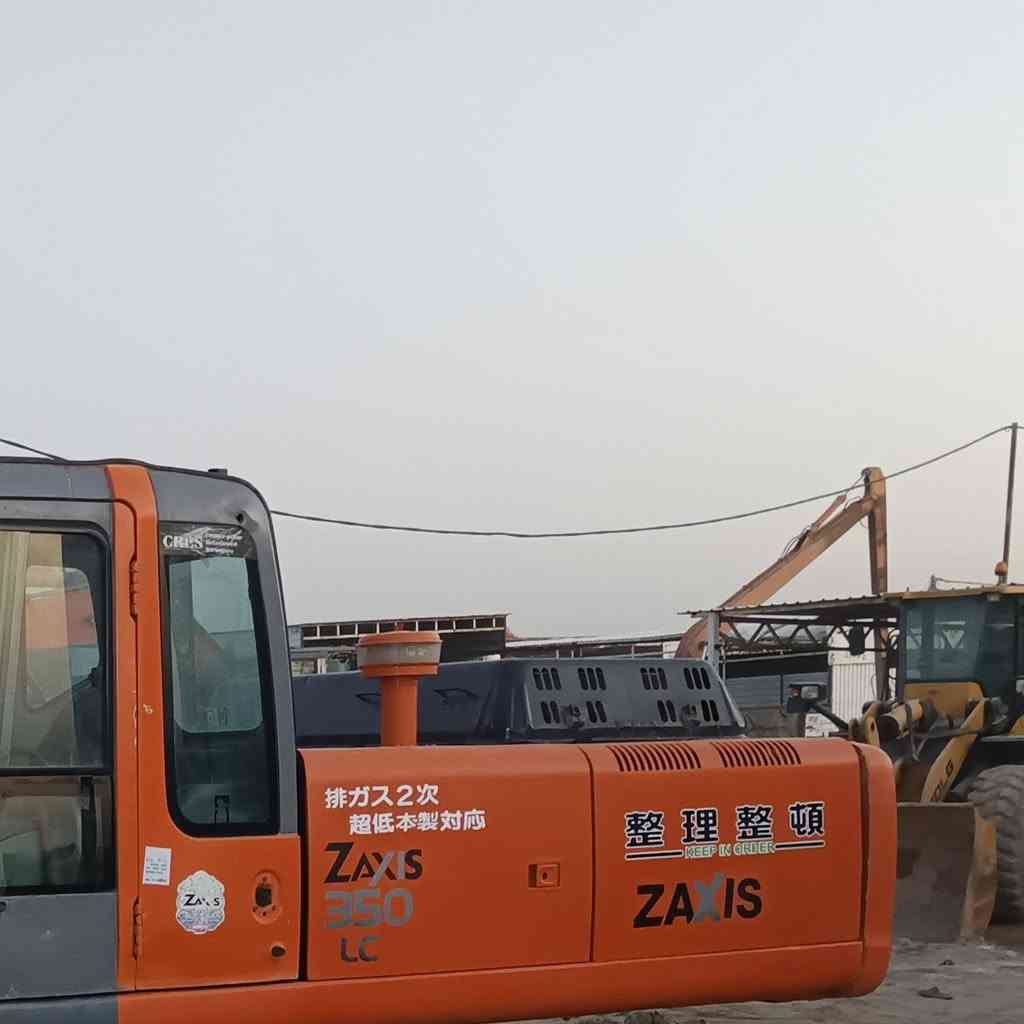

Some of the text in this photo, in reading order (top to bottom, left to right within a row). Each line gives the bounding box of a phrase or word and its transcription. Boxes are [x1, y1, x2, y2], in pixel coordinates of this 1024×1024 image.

[625, 801, 825, 848] 整理整頓
[324, 842, 423, 887] ZAXIS
[684, 845, 716, 858] KEEP
[719, 844, 732, 856] IN
[324, 888, 414, 929] 350
[633, 872, 762, 928] ZAXIS
[339, 935, 384, 962] LC
